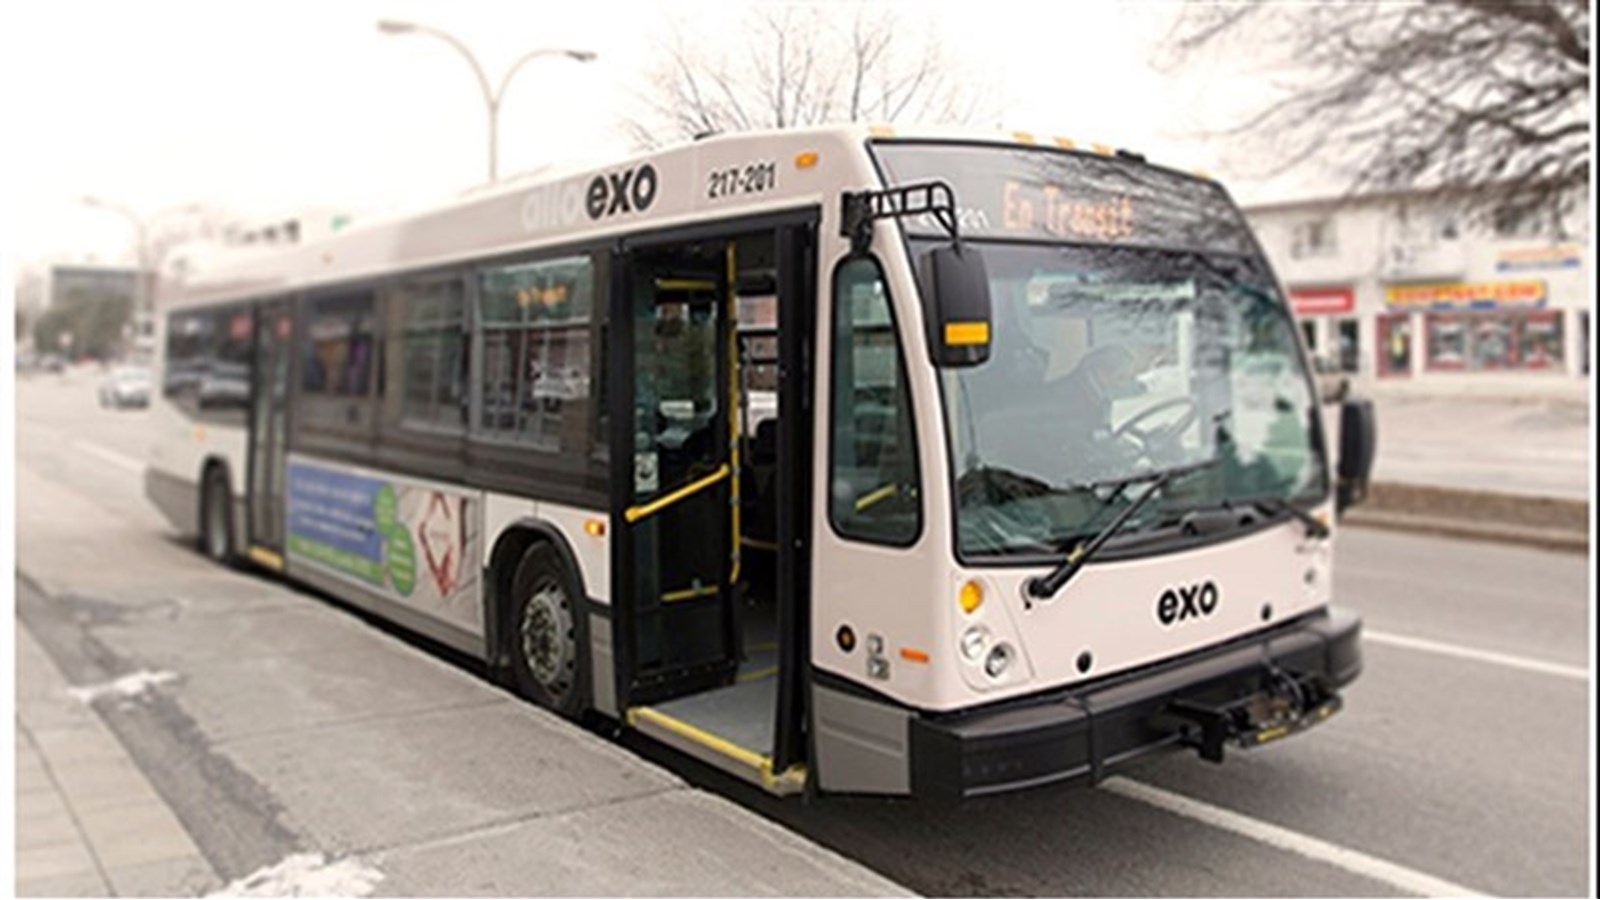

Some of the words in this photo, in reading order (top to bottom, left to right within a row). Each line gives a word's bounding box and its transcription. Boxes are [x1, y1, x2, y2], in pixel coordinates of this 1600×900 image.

[586, 163, 657, 221] exo
[708, 162, 776, 199] 217-201
[1003, 181, 1033, 229] En
[1043, 184, 1133, 237] Transit
[1157, 579, 1219, 627] exo
